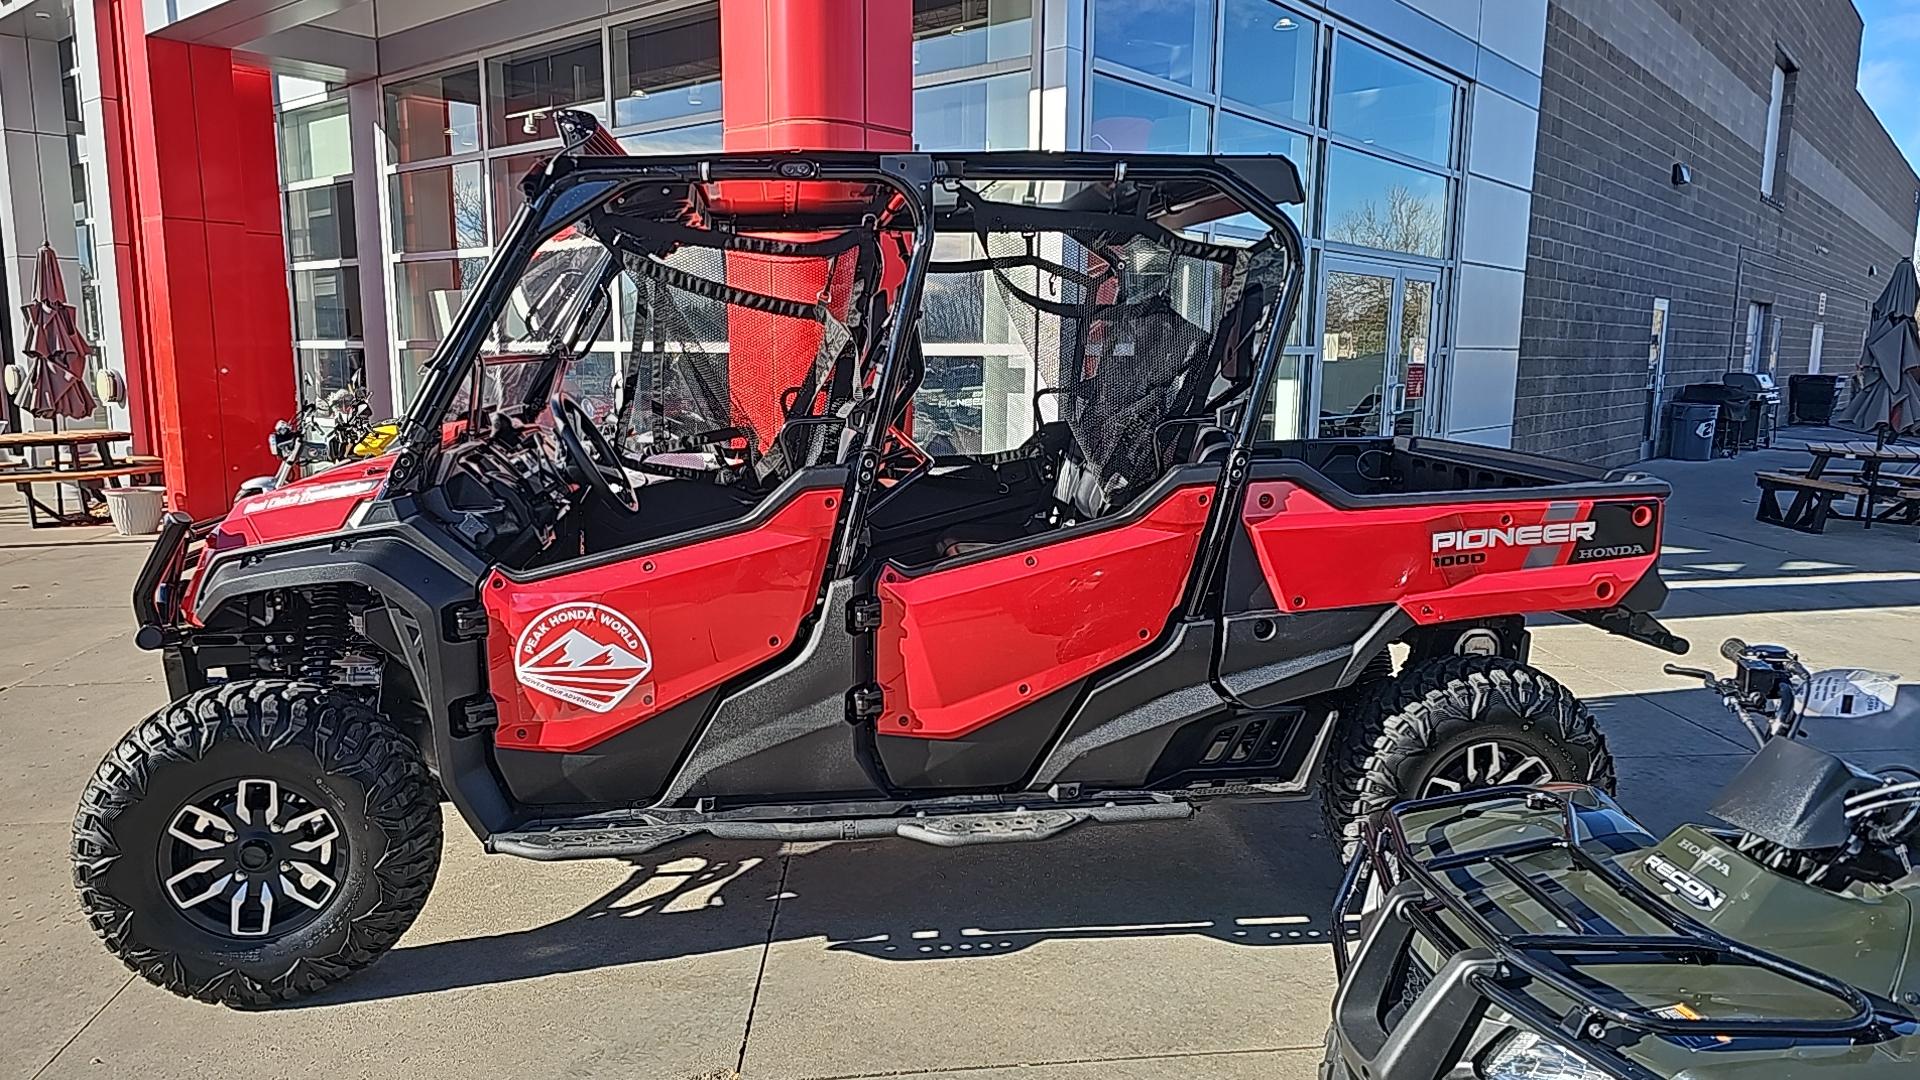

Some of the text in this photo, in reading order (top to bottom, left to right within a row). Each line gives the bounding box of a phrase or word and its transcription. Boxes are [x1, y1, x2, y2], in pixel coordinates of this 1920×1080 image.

[1432, 521, 1596, 553] PIONEER
[1578, 544, 1646, 560] HONDA
[1433, 552, 1487, 568] 1000
[524, 609, 639, 655] PEAK HONDA WORLD
[521, 675, 602, 709] POWER YOUR ADVENTURE
[1677, 838, 1731, 877] HONDA
[1644, 854, 1725, 910] RECON
